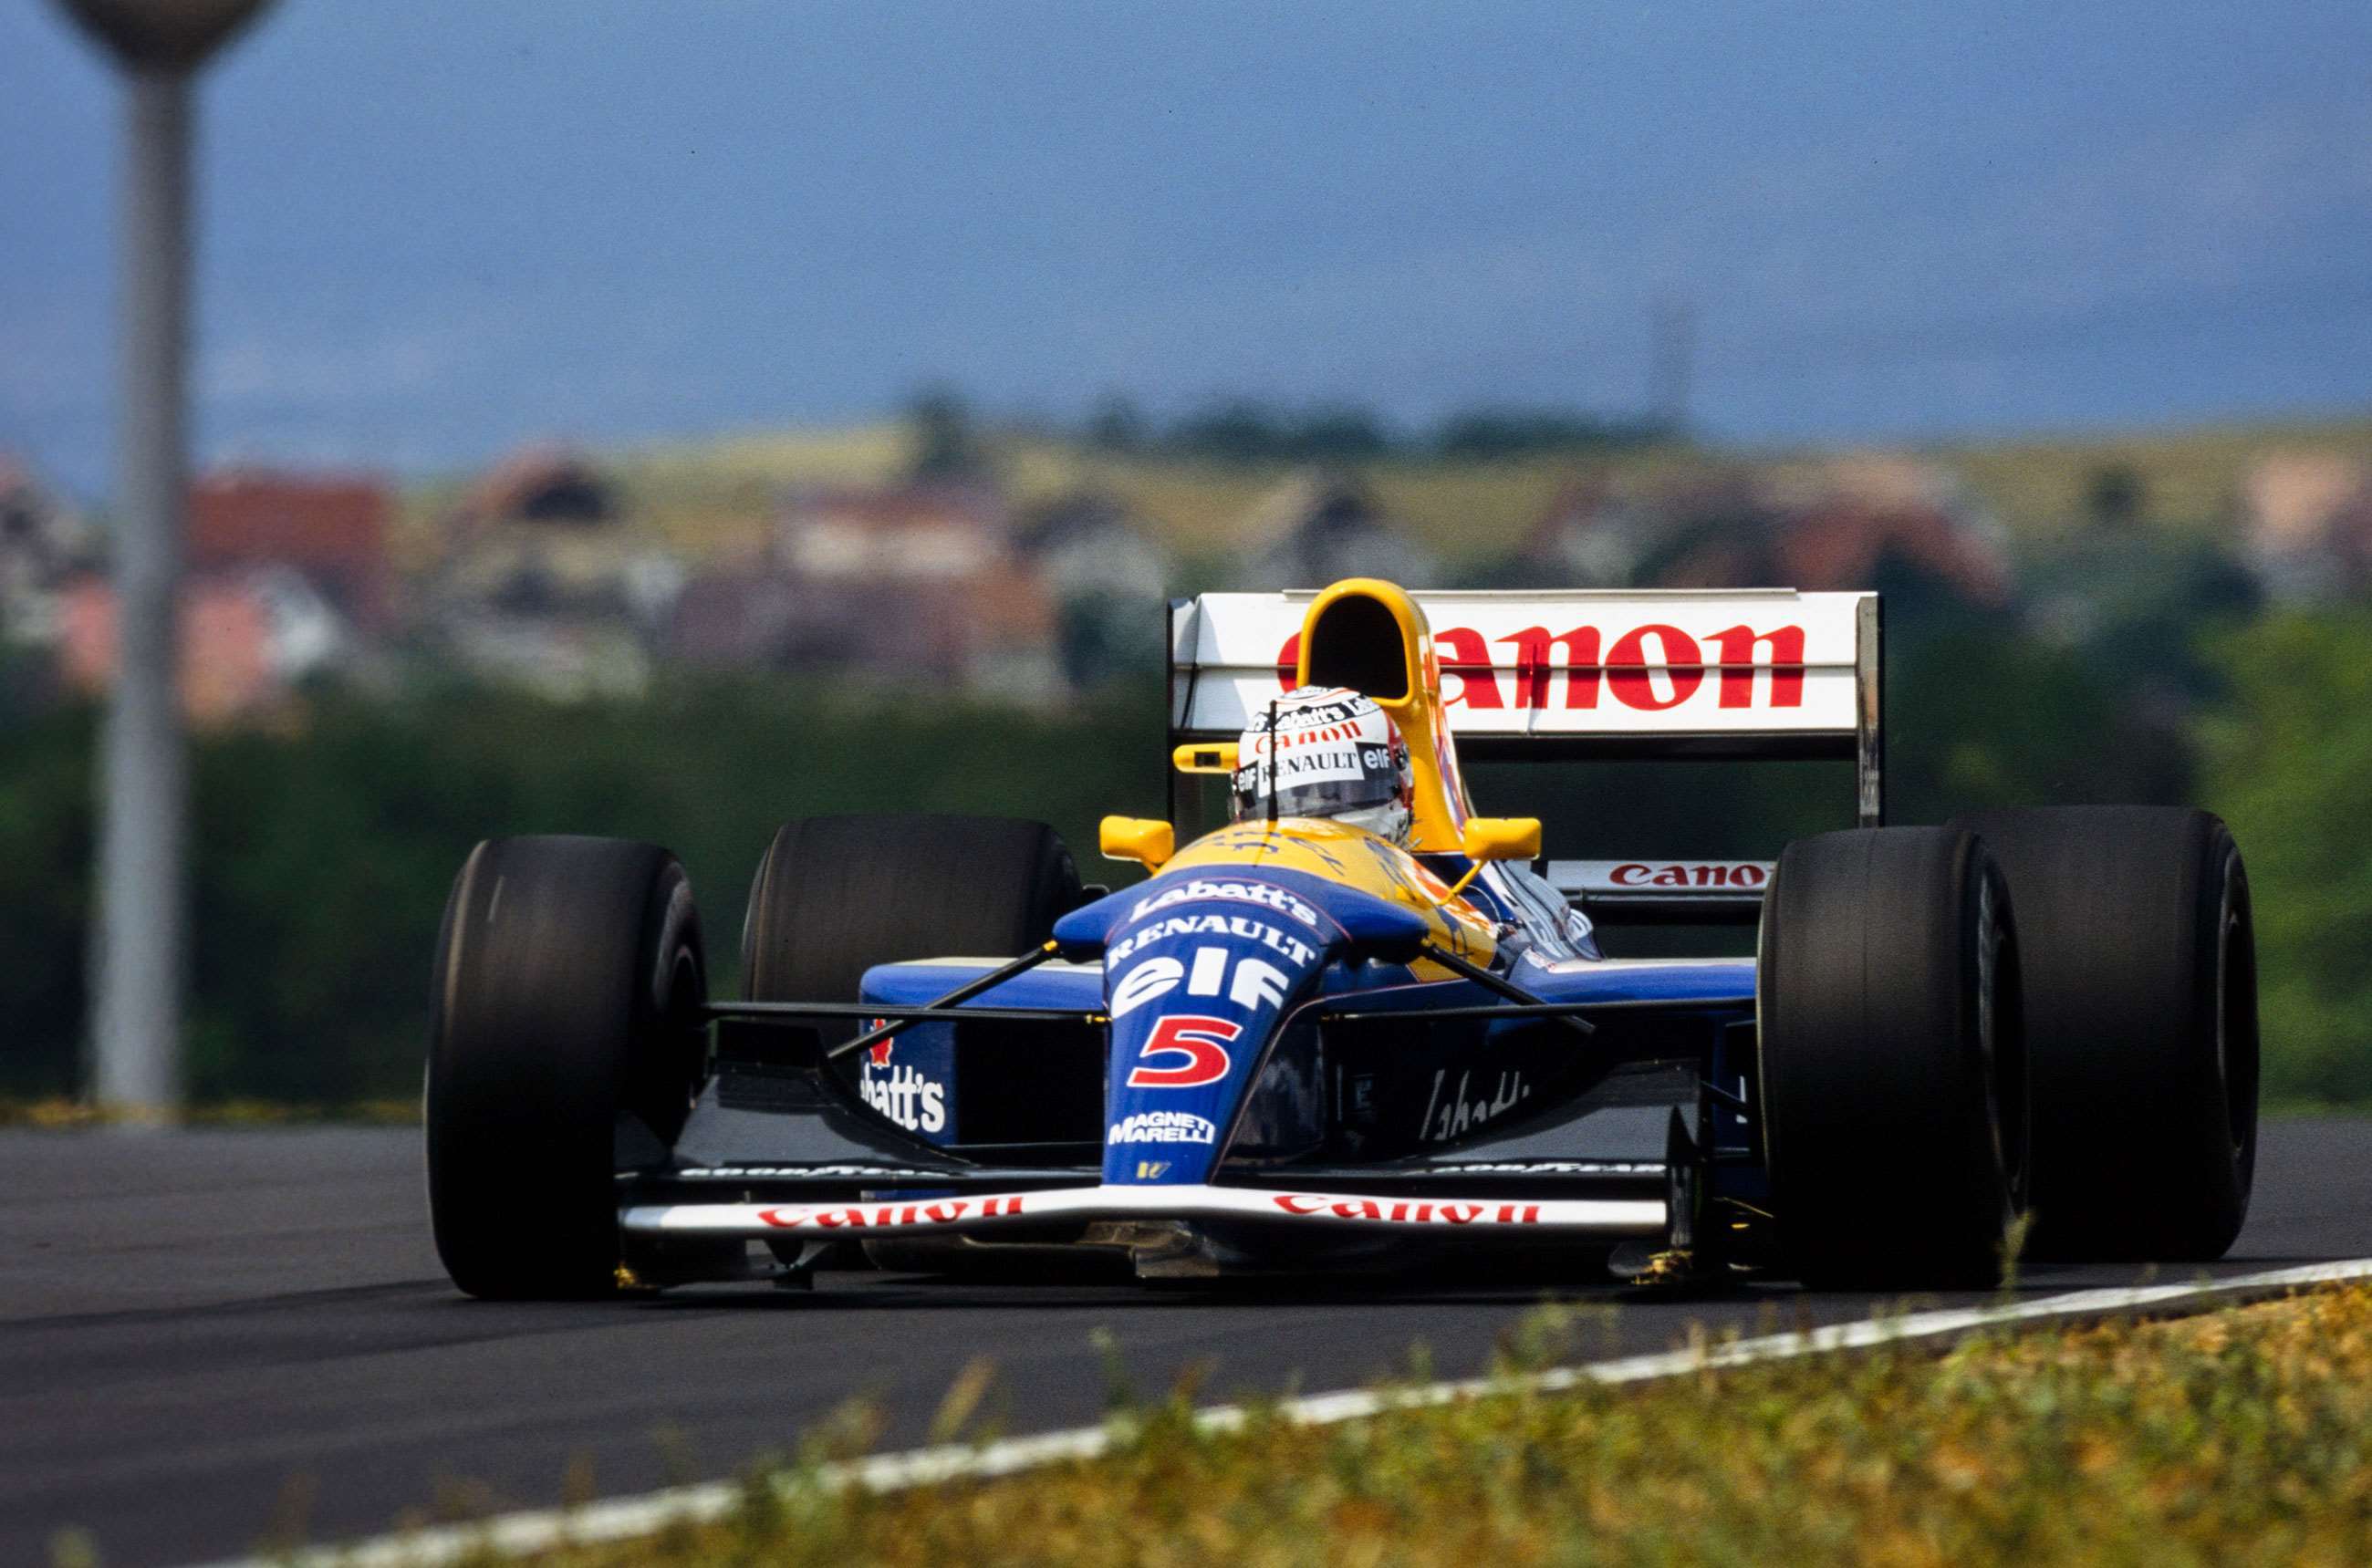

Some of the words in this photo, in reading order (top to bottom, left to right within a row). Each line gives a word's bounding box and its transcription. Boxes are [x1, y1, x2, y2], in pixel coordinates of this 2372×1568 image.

[1363, 748, 1389, 770] elf
[1609, 863, 1776, 887] Cano
[1129, 880, 1317, 927] Labatt's
[1107, 915, 1316, 972] RENAULT
[1110, 947, 1289, 1020] elf
[1126, 1014, 1243, 1087] 5
[860, 1062, 945, 1133] batt's
[1108, 1122, 1215, 1146] MARELLI
[757, 1197, 1024, 1228] Canon
[1273, 1194, 1540, 1224] Canon
